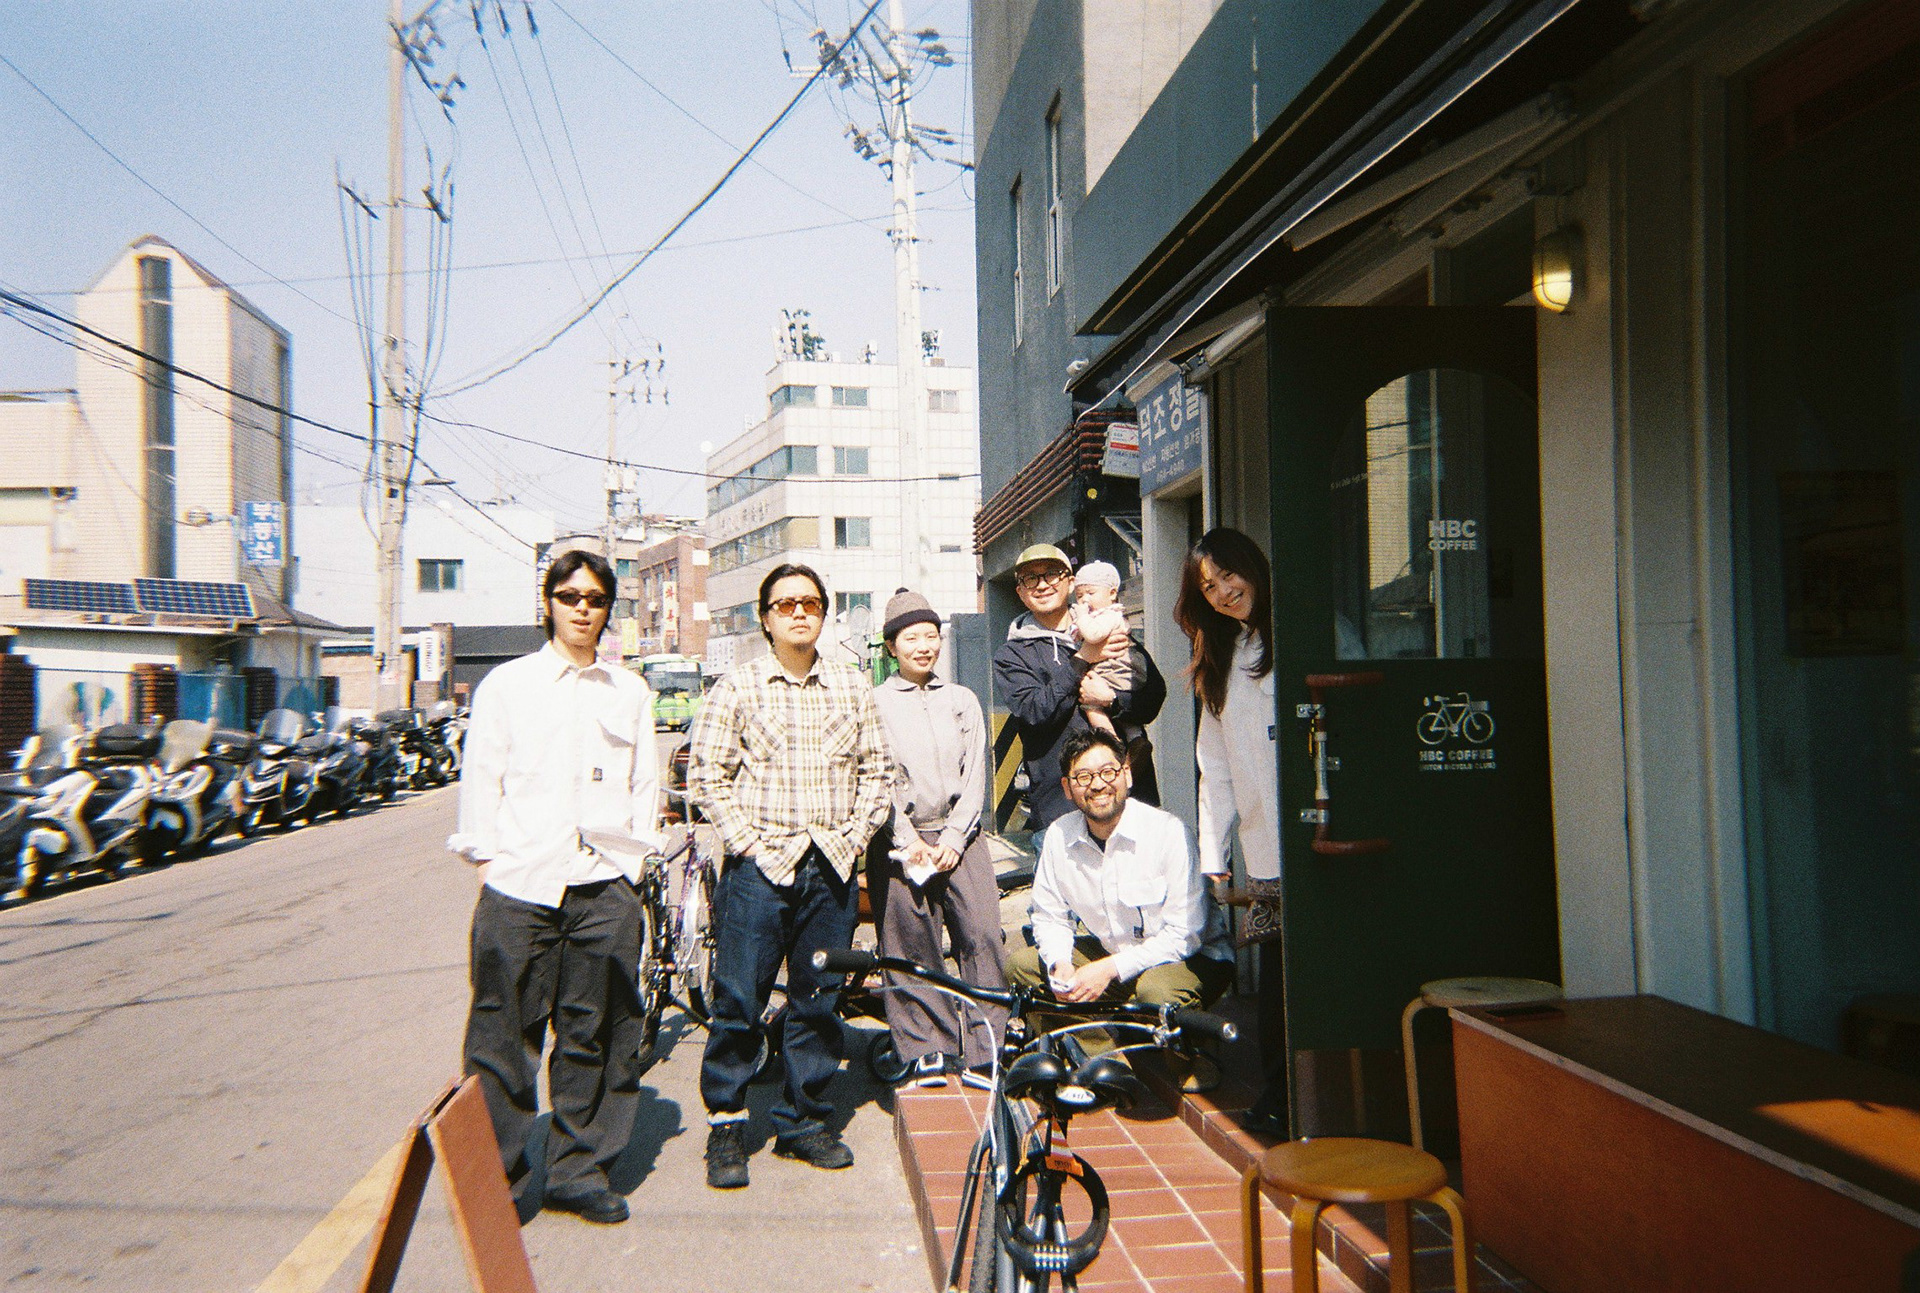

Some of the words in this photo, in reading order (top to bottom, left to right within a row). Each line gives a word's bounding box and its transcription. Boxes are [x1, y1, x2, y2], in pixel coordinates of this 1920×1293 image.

[1428, 519, 1477, 538] HBC
[1428, 539, 1477, 551] COFFEE
[1419, 749, 1444, 761] HBC
[1448, 749, 1493, 760] COFFEE
